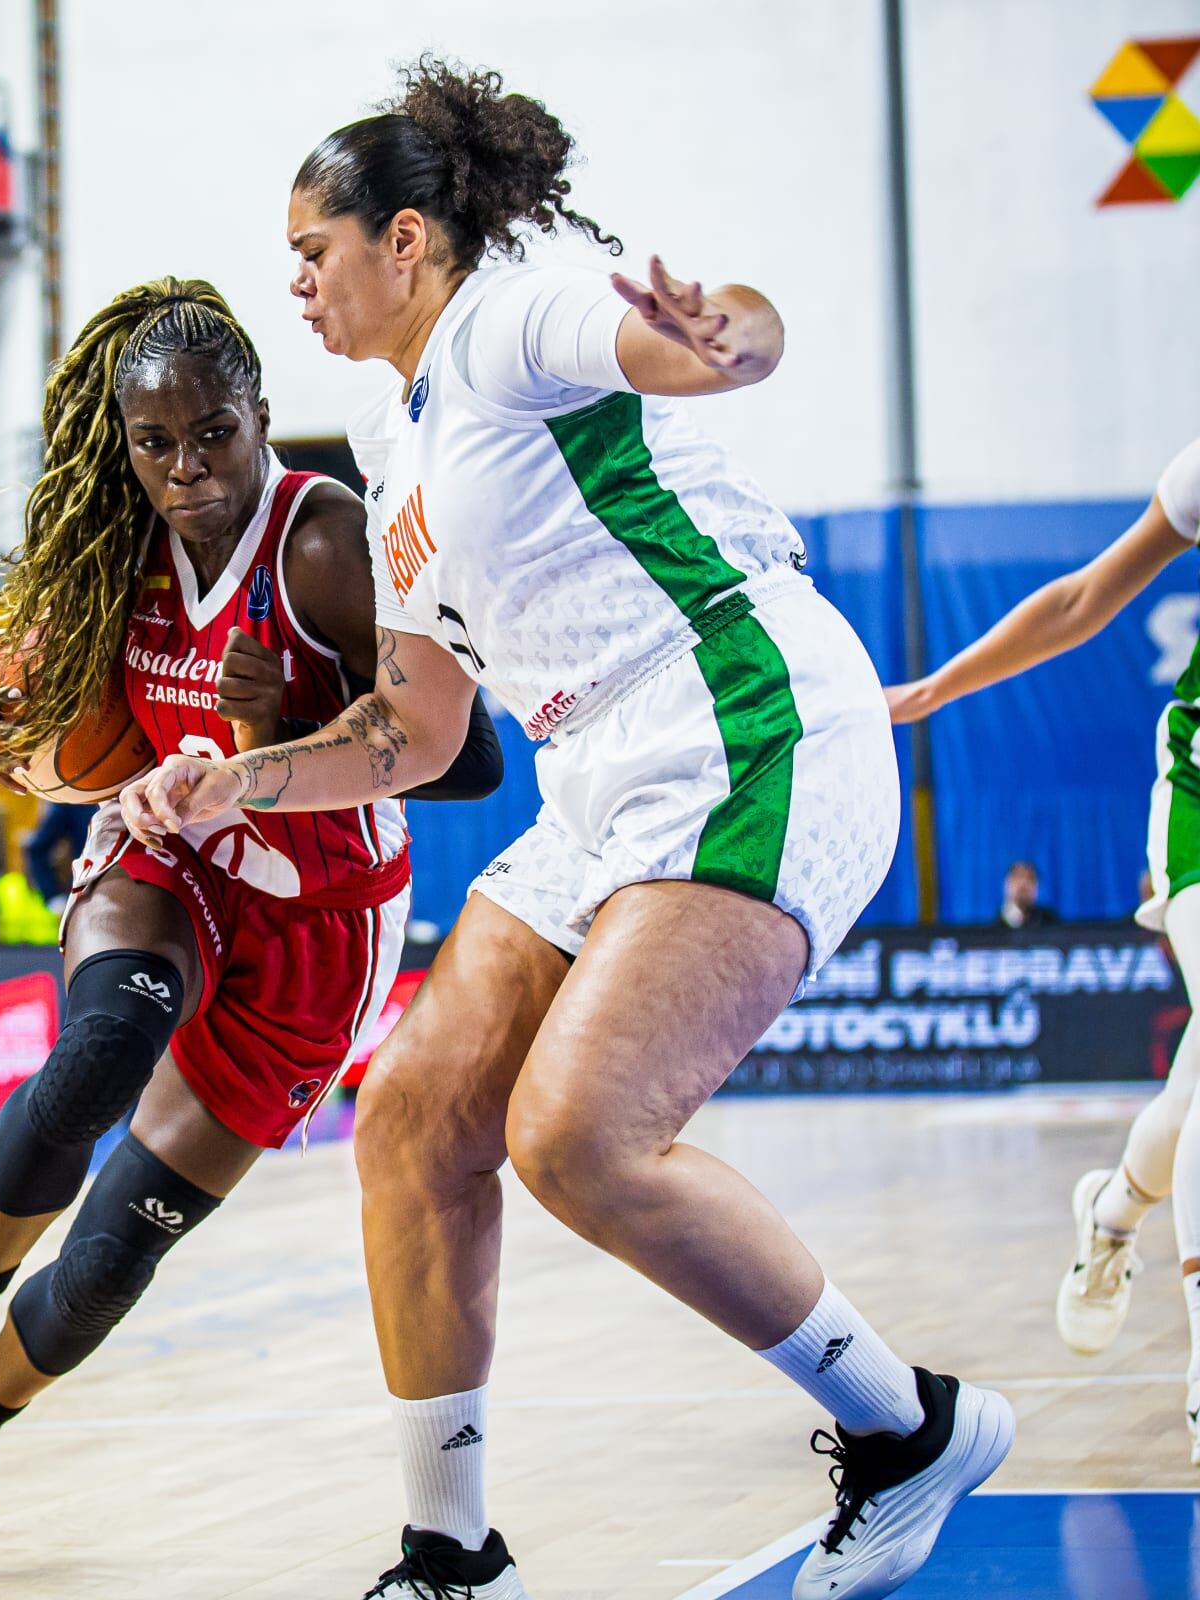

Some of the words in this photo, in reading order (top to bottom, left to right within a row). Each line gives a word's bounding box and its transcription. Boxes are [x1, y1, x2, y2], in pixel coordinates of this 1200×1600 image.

[382, 484, 437, 608] ABINY
[145, 683, 222, 711] ZARAGOZ
[890, 938, 1173, 996] PŘEPRAVA
[816, 1333, 855, 1374] adidas
[441, 1434, 483, 1450] adidas
